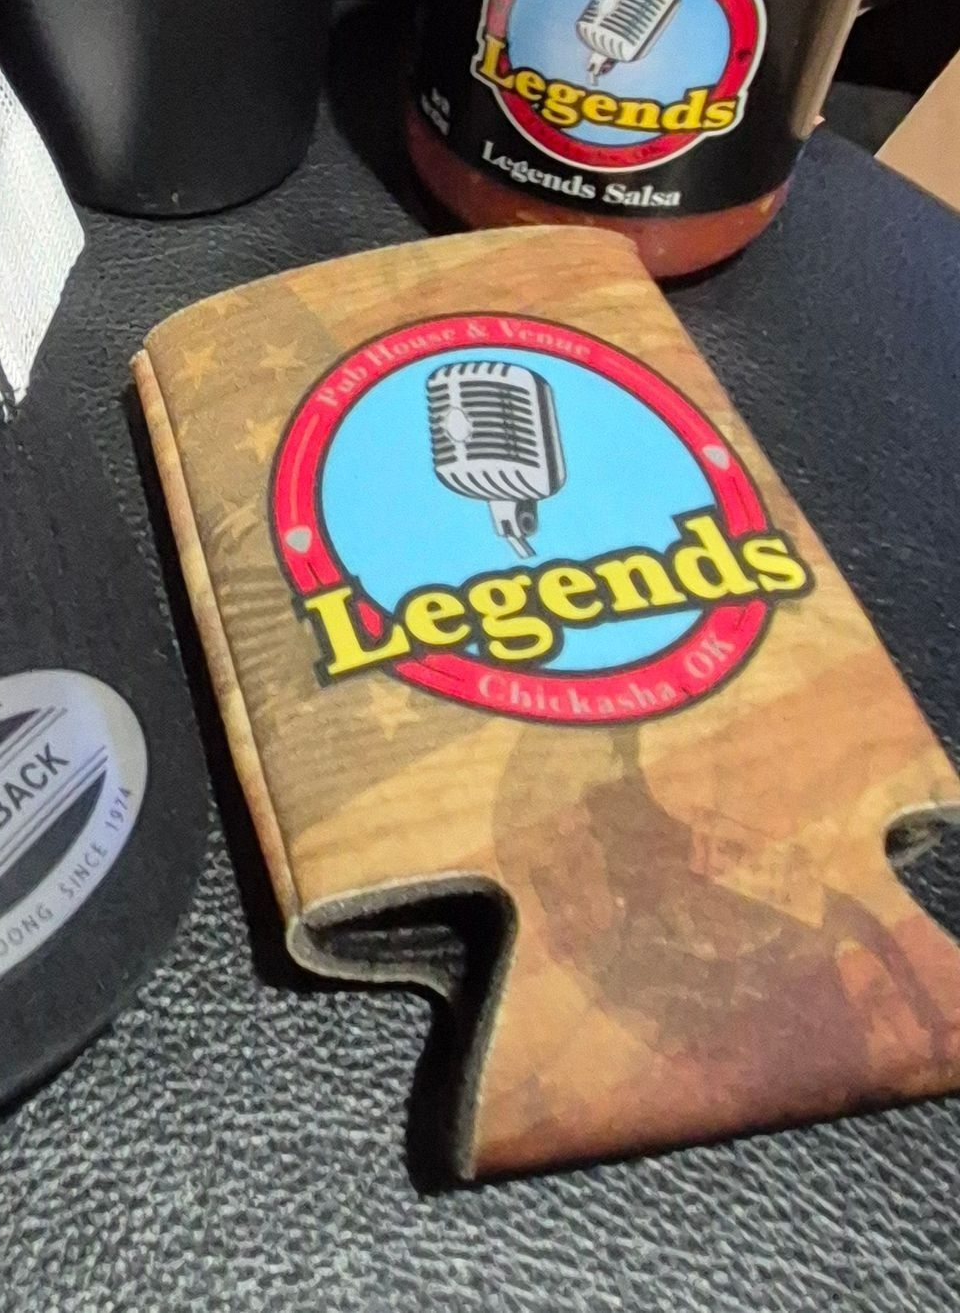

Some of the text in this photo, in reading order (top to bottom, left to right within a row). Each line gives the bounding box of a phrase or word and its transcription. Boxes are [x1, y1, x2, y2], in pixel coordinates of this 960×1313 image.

[477, 33, 737, 132] Legends
[482, 140, 596, 200] Legends
[601, 183, 683, 207] Salsa
[316, 318, 592, 408] Pub House & Venue
[306, 515, 808, 677] Legends
[477, 631, 736, 716] Chickasha OK
[60, 843, 108, 900] SINCE
[105, 786, 132, 833] 1974
